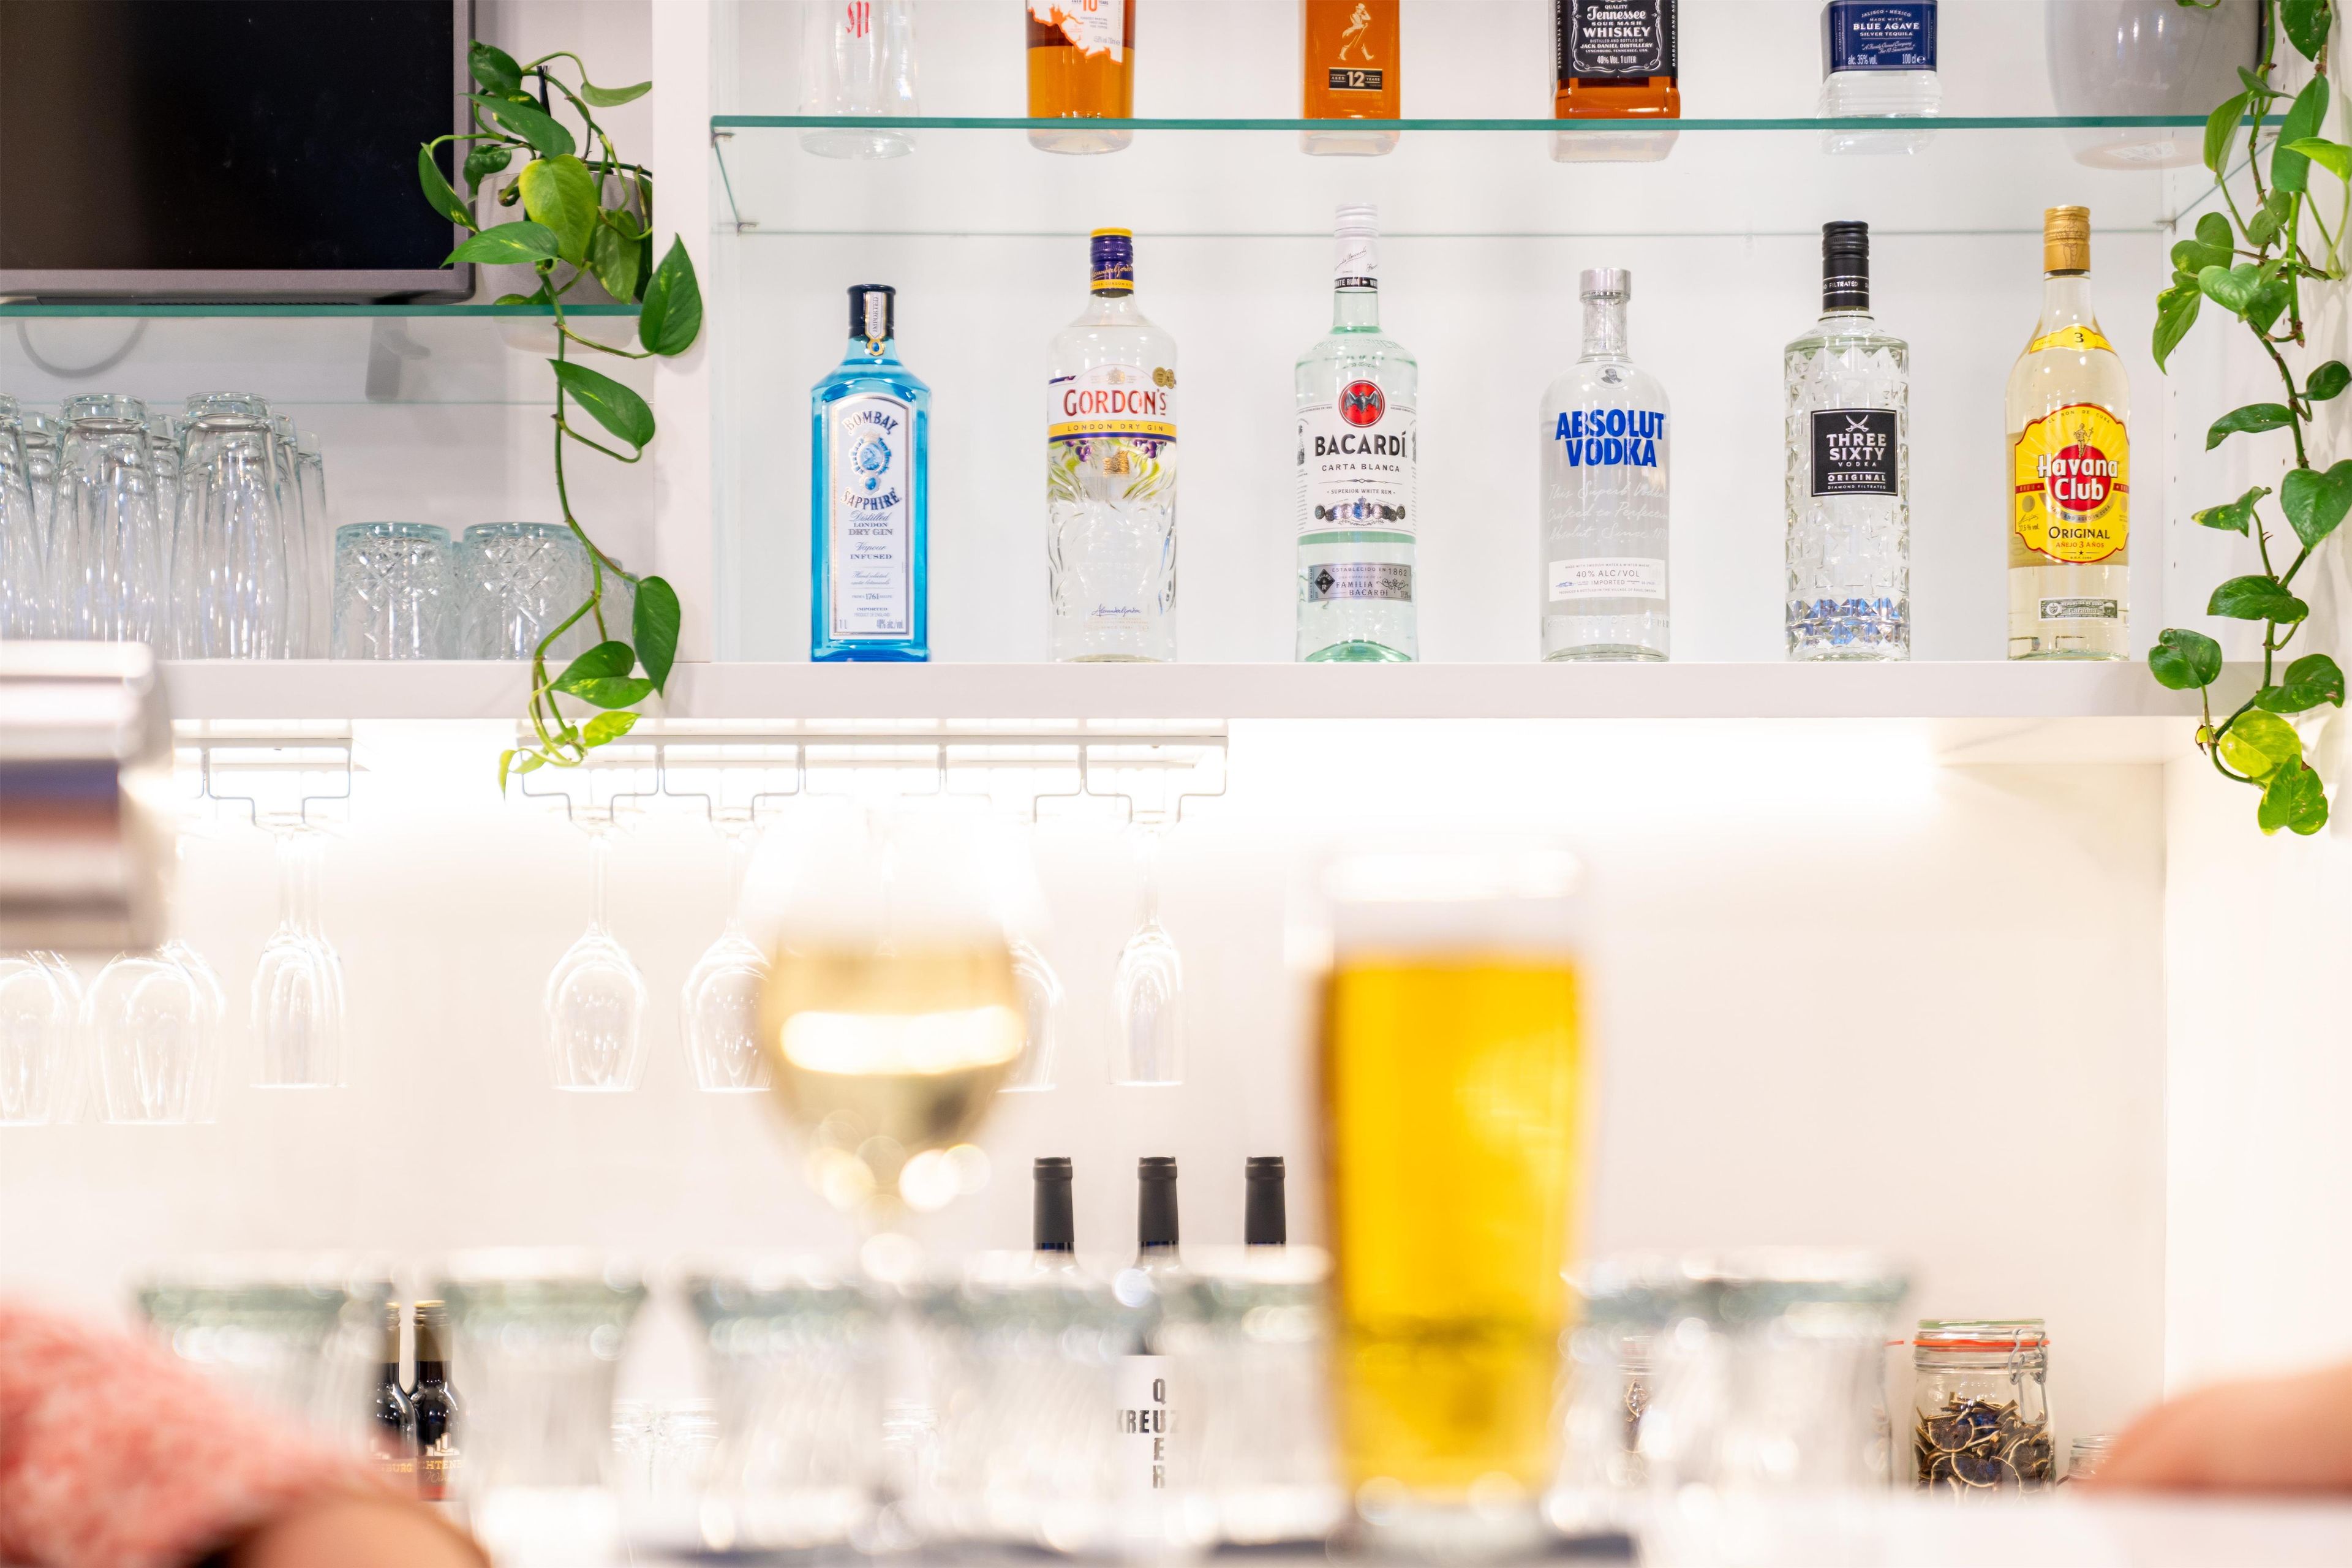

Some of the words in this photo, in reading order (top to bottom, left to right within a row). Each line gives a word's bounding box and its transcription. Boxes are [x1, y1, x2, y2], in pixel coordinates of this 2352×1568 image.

[1587, 6, 1646, 20] Tennessee
[1583, 27, 1651, 38] WHISKEY
[1597, 56, 1609, 64] 40%
[1857, 55, 1868, 65] 35%
[1902, 54, 1912, 64] 100
[1347, 71, 1365, 87] 12
[2074, 332, 2084, 343] 3
[1063, 388, 1167, 417] GORDON'S
[843, 410, 899, 435] BOMBAY
[1555, 409, 1665, 440] ABSOLUT
[2096, 413, 2110, 423] CUBA
[1315, 430, 1406, 458] BACARDÍ
[1826, 433, 1887, 447] THREE
[1566, 437, 1657, 467] VODKA
[1829, 447, 1885, 461] SIXTY
[1361, 463, 1400, 472] BLANCA
[2037, 453, 2119, 478] Havana
[2054, 477, 2105, 500] Club
[840, 488, 900, 510] SAPPHIRE
[849, 510, 892, 522] Distilled
[2049, 526, 2111, 539] ORIGINAL
[855, 541, 887, 553] Vapour
[1388, 568, 1407, 576] 1862
